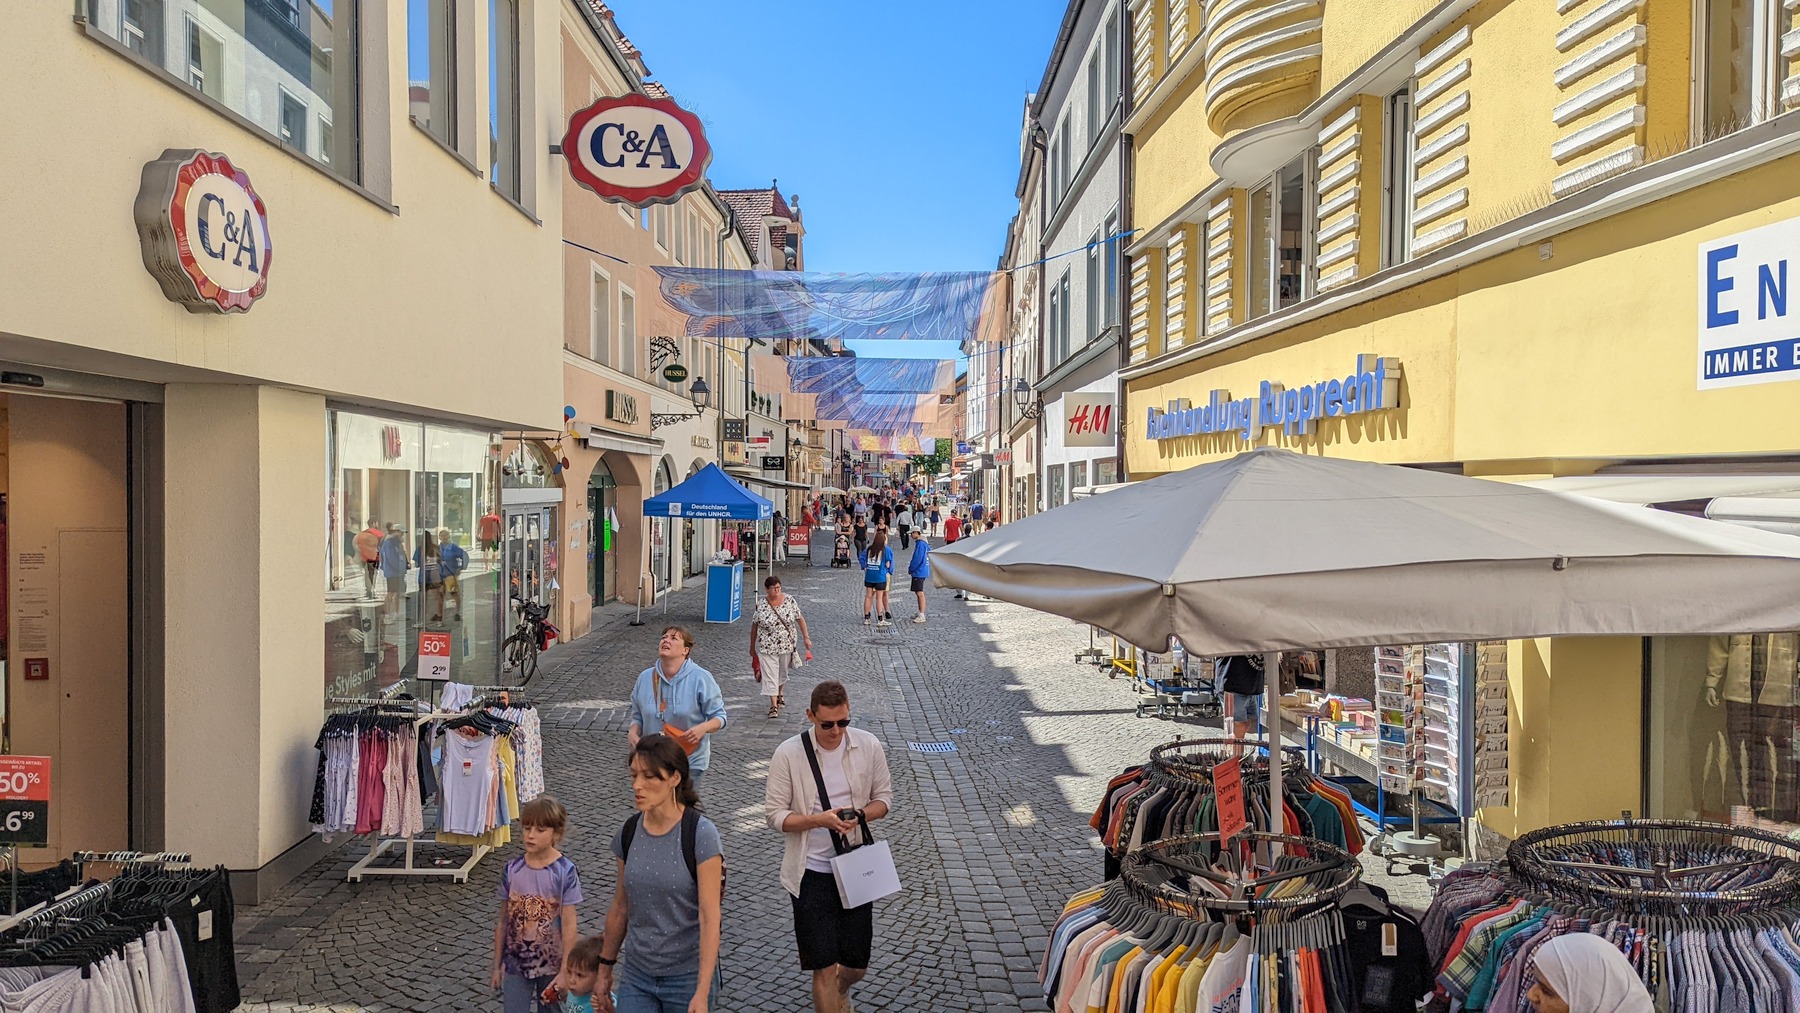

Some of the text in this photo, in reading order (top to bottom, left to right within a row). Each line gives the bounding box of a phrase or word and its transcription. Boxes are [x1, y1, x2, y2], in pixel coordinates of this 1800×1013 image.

[589, 122, 681, 169] C&A
[198, 193, 259, 273] C&A
[1706, 346, 1778, 376] IMMER
[1146, 354, 1387, 440] Buchhandlung Rupprecht
[1068, 404, 1111, 435] H&M
[790, 533, 807, 541] 50%
[423, 640, 446, 653] 50%
[335, 670, 362, 696] Styles
[363, 661, 377, 683] mit
[0, 772, 40, 793] 50%
